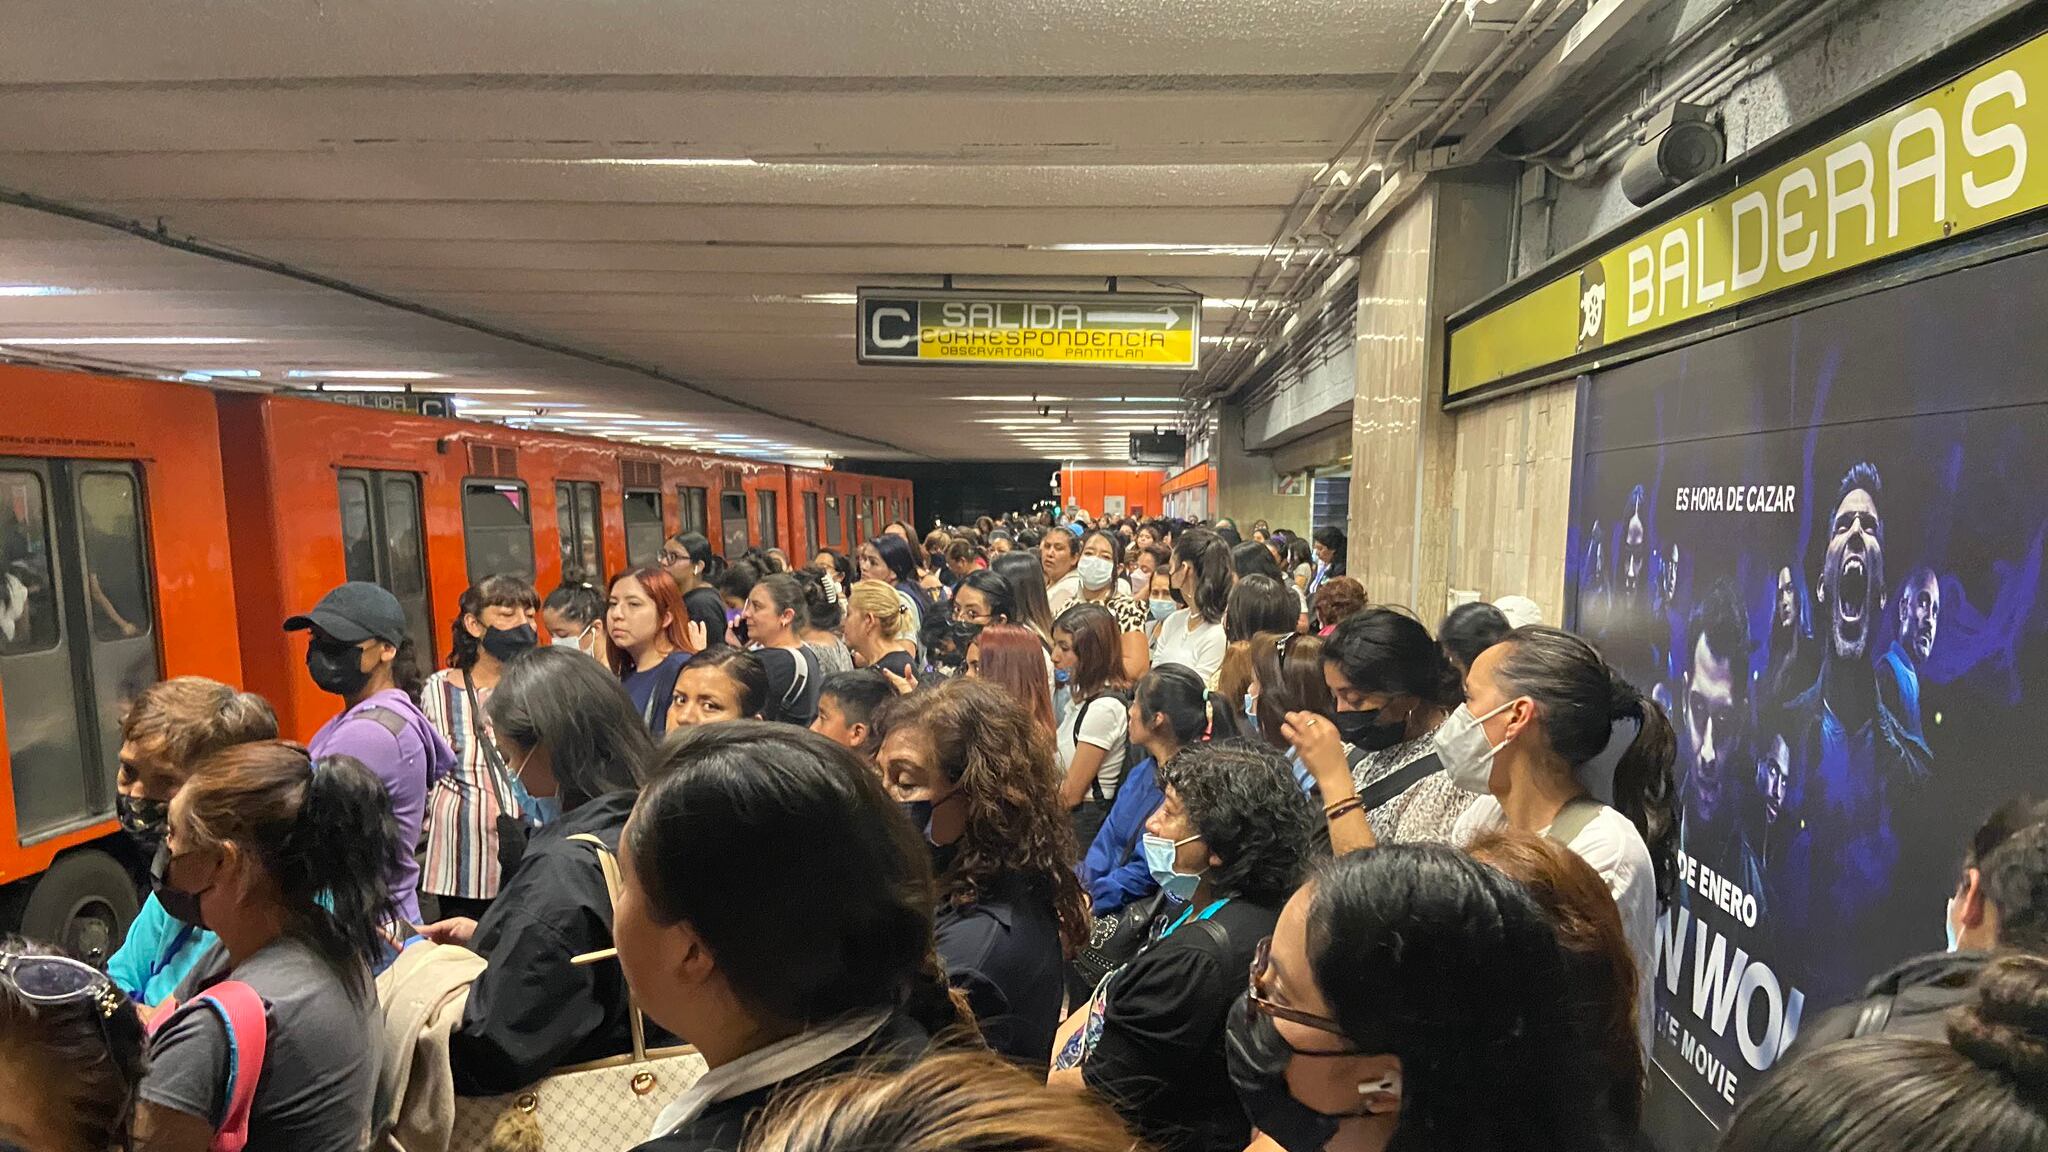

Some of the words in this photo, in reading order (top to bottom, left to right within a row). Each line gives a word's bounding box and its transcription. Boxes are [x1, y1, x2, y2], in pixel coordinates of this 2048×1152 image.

[1627, 69, 2029, 327] BALDERAS
[872, 308, 911, 349] C
[942, 303, 1082, 330] SALIDA
[920, 327, 1165, 348] CORRESPONDENCIA
[940, 346, 1045, 357] OBSERVATORIO
[1065, 347, 1144, 359] PANTITLAN
[334, 394, 407, 411] SALIDA
[1675, 487, 1690, 511] ES
[1690, 486, 1724, 511] HORA
[1726, 486, 1746, 512] DE
[1746, 485, 1796, 512] CAZAR
[1677, 849, 1697, 889] DE
[1699, 864, 1757, 928] ENERO
[1681, 1028, 1738, 1106] MOVIE
